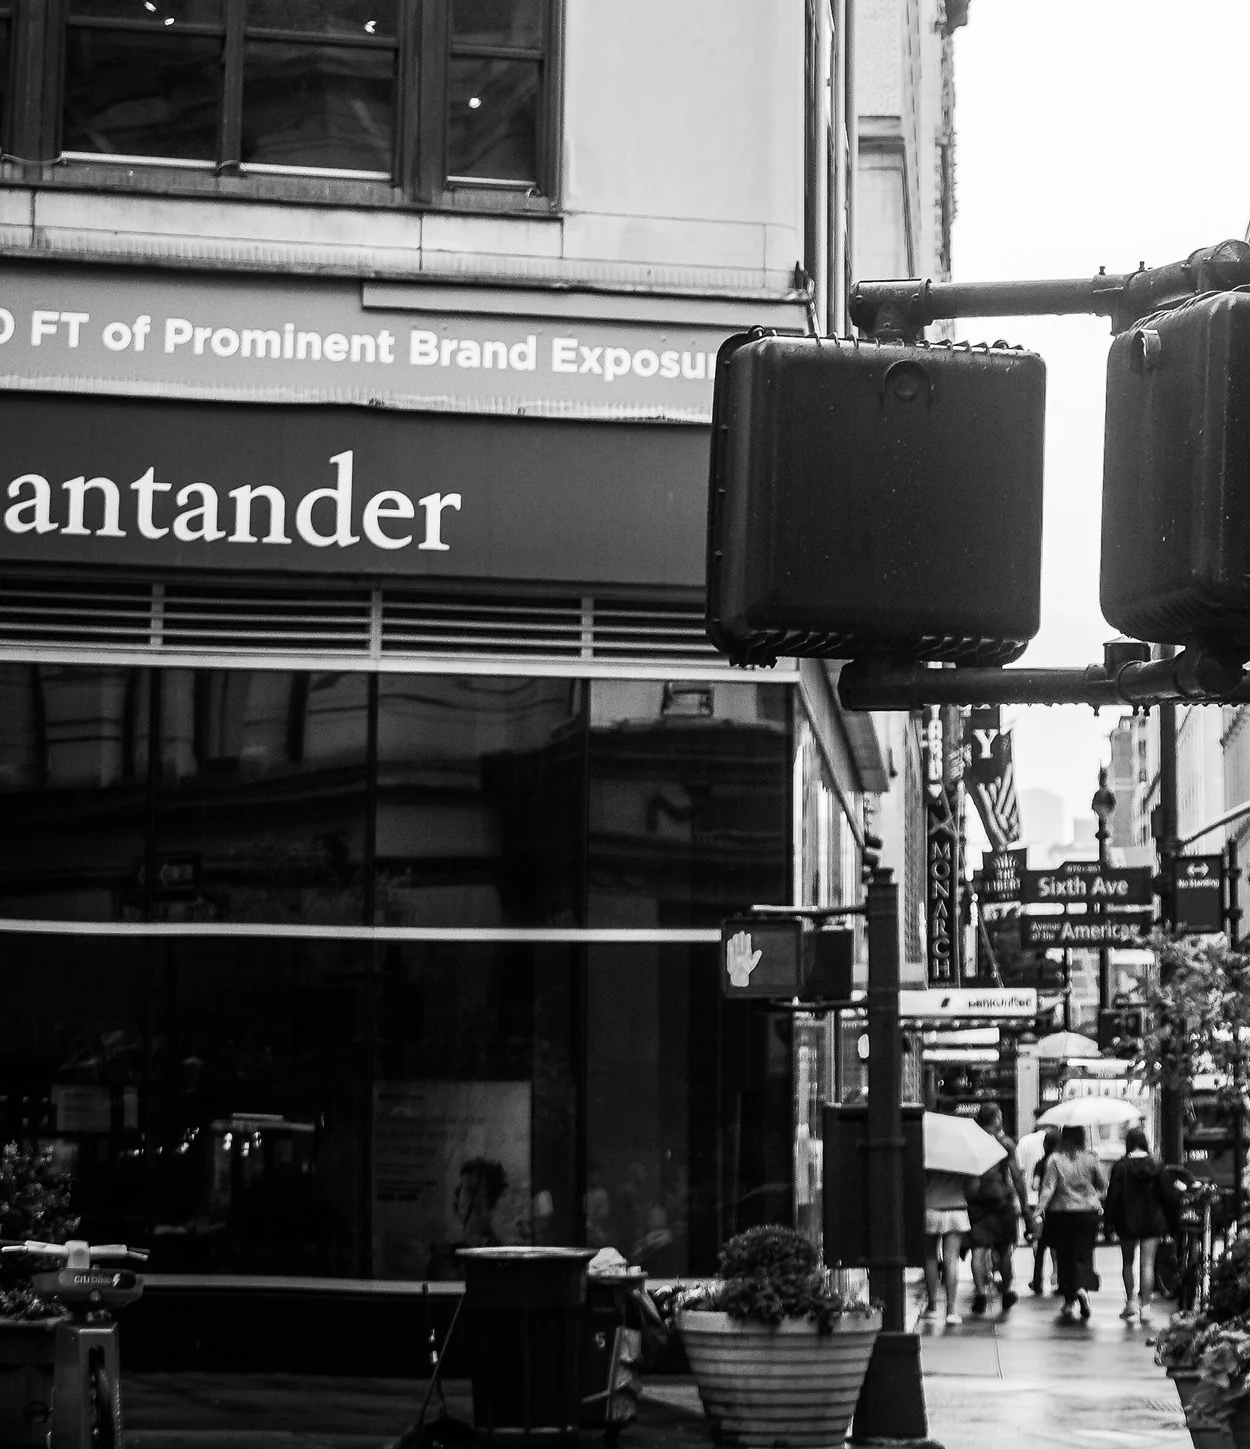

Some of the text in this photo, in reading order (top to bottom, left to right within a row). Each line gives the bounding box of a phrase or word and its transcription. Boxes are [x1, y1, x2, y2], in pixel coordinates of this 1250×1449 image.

[31, 310, 90, 349] FT
[102, 315, 152, 351] of
[163, 318, 395, 365] Prominent
[408, 328, 537, 372] Brand
[3, 449, 462, 552] antander
[930, 841, 952, 979] MONARCH
[1038, 876, 1129, 897] Sixth Ave
